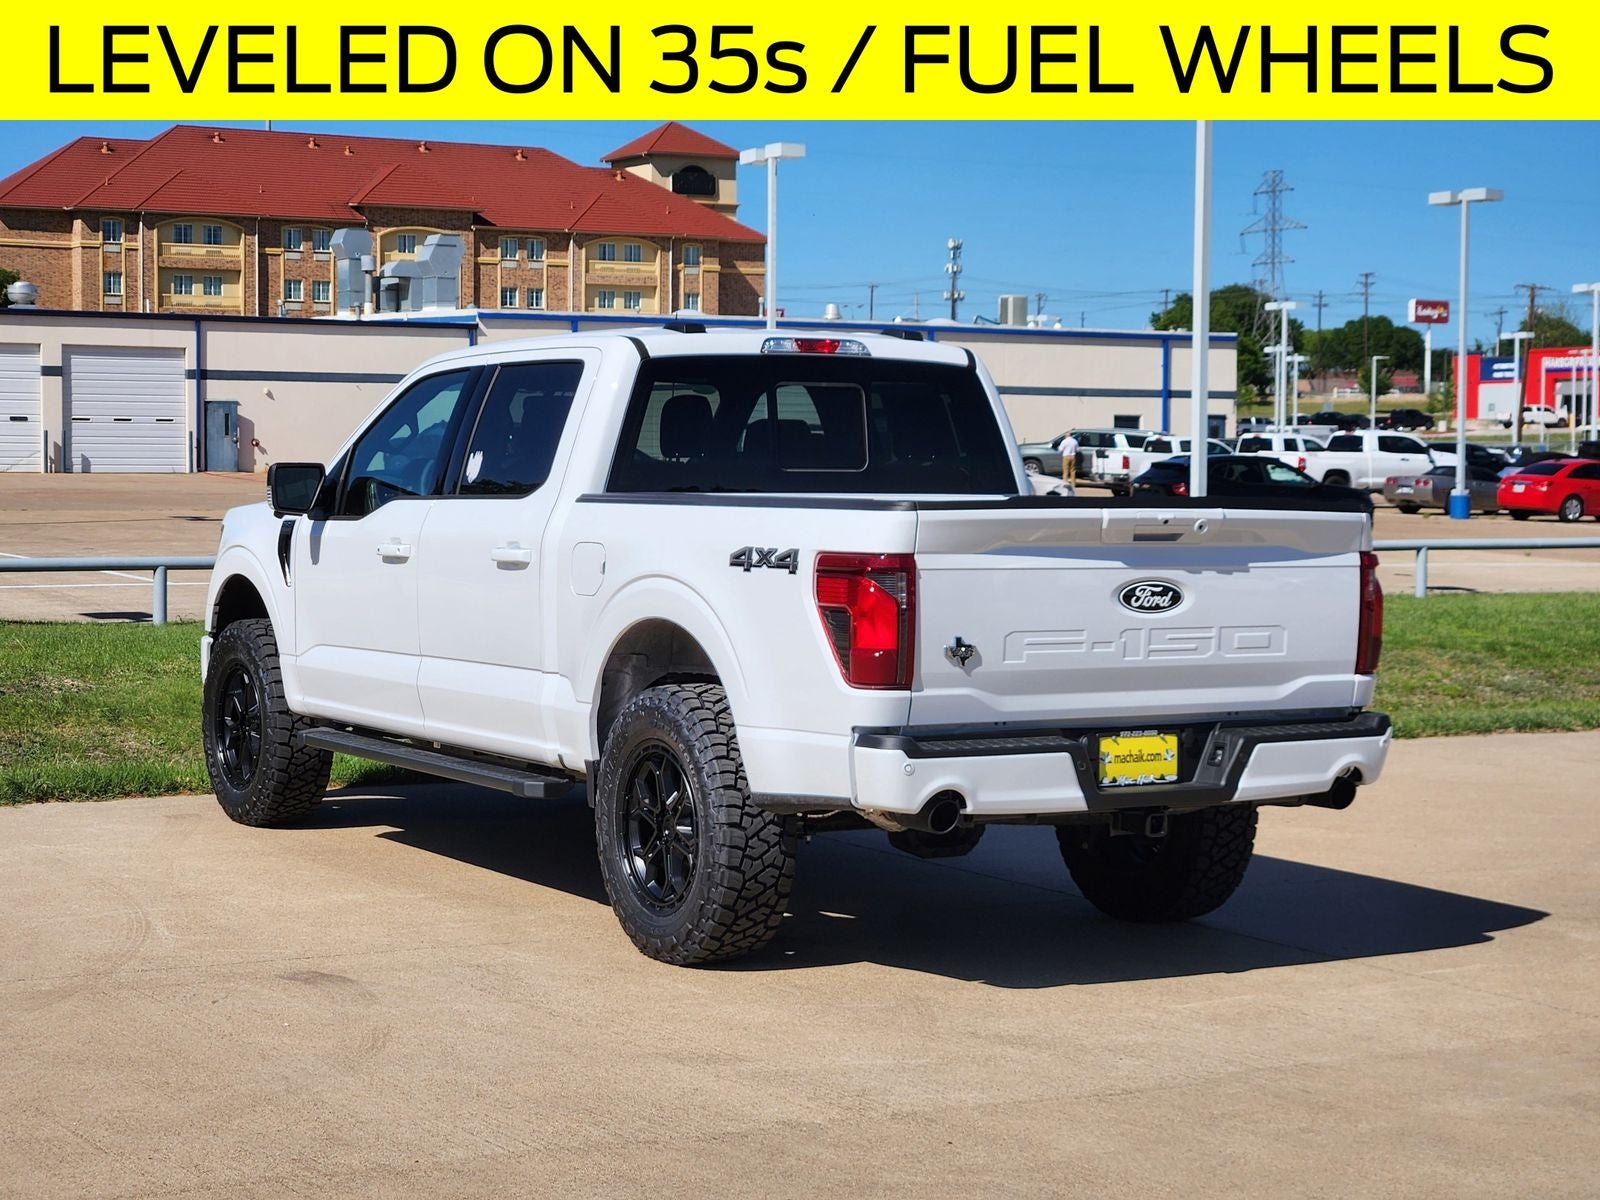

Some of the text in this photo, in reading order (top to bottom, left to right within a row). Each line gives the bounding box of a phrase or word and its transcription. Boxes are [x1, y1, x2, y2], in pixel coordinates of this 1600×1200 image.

[1130, 585, 1174, 608] Ford
[1002, 624, 1287, 663] F-150
[1113, 748, 1163, 764] machaik.com
